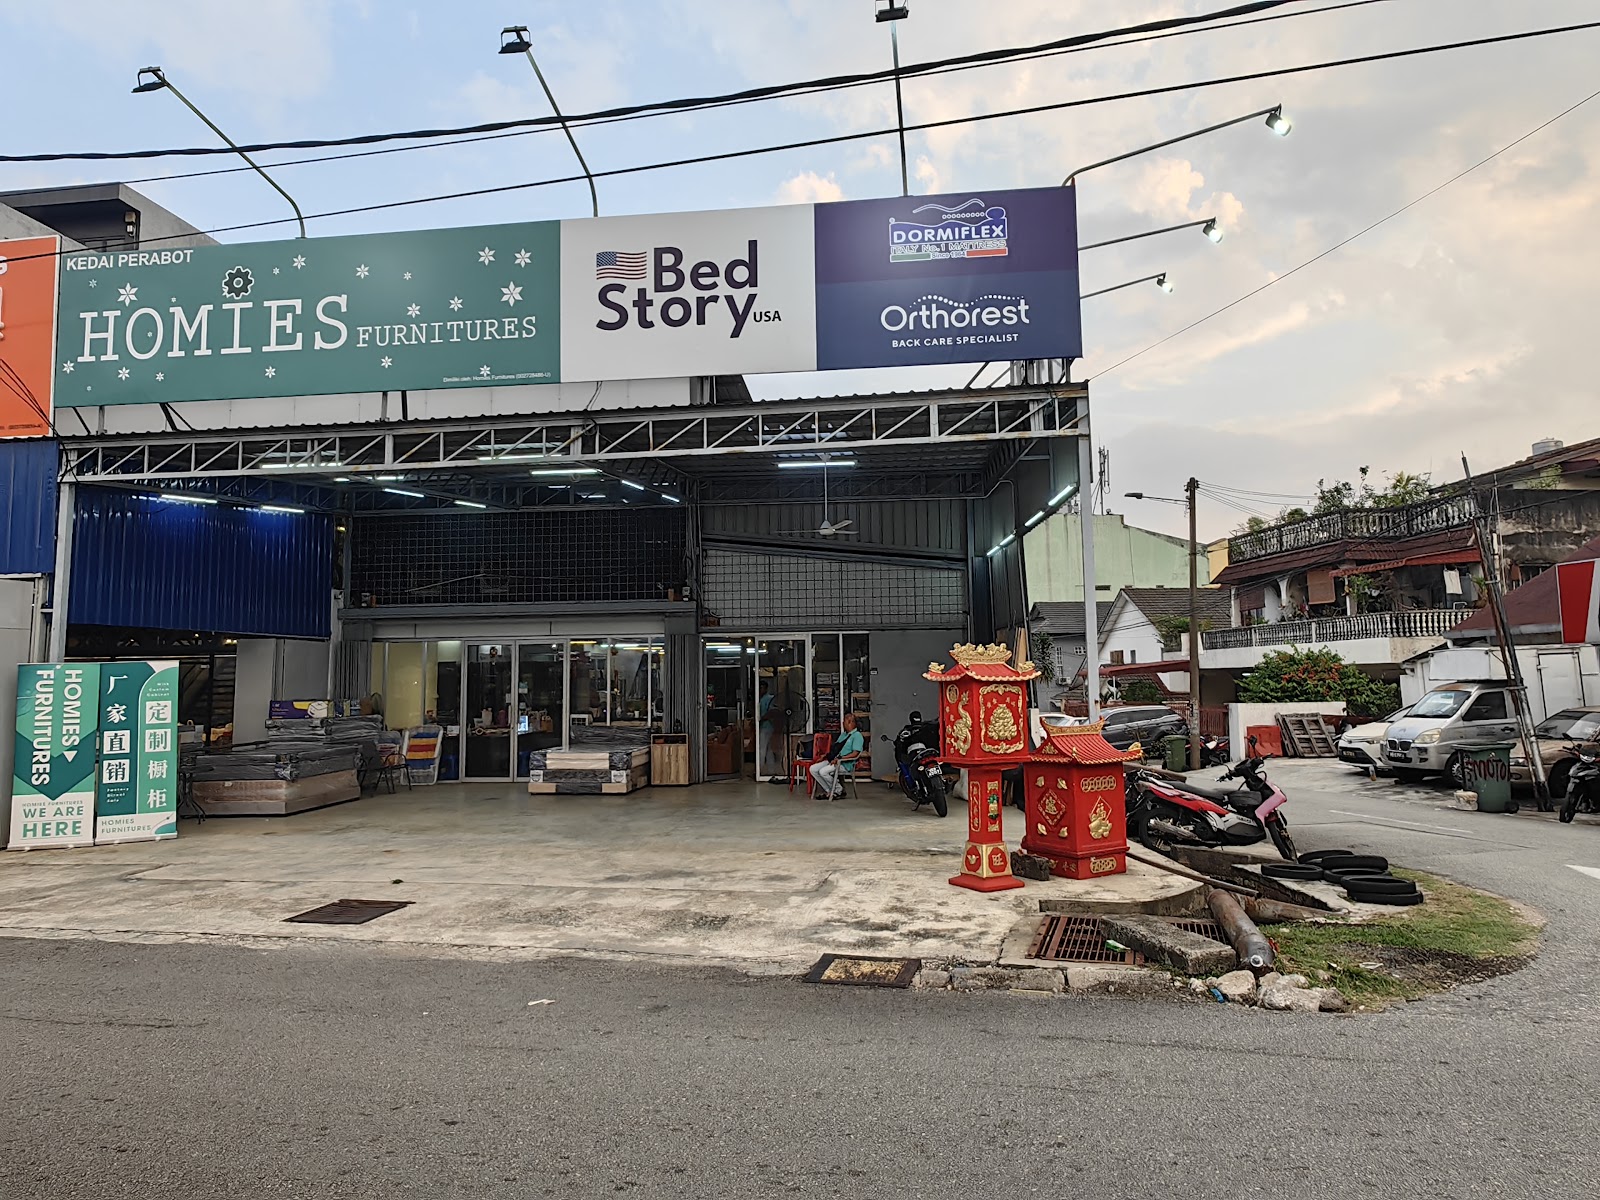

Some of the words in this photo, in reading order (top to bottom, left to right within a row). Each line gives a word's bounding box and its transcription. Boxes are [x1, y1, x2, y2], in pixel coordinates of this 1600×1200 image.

[890, 245, 919, 254] ITALY
[948, 239, 1007, 251] MATTRESS
[893, 224, 1004, 243] DORMIFLEX
[66, 254, 114, 271] KEDAI
[118, 250, 194, 268] PERABOT
[653, 239, 758, 293] Bed
[596, 283, 758, 338] Story
[753, 310, 782, 322] USA
[880, 299, 1030, 331] Orthorest
[77, 294, 348, 362] HOMIES
[356, 316, 537, 347] FURNITURES
[892, 338, 921, 348] BACK
[924, 337, 953, 347] CARE
[956, 334, 1019, 345] SPECIALIST
[61, 669, 83, 747] HOMIES
[31, 669, 55, 786] FURNITURES
[106, 674, 129, 782] 厂家直销
[146, 702, 168, 808] 定制橱柜
[23, 807, 46, 819] WE
[53, 805, 84, 817] ARE
[101, 818, 134, 826] HOMIES
[22, 820, 82, 838] HERE
[101, 825, 151, 834] FURNITURES
